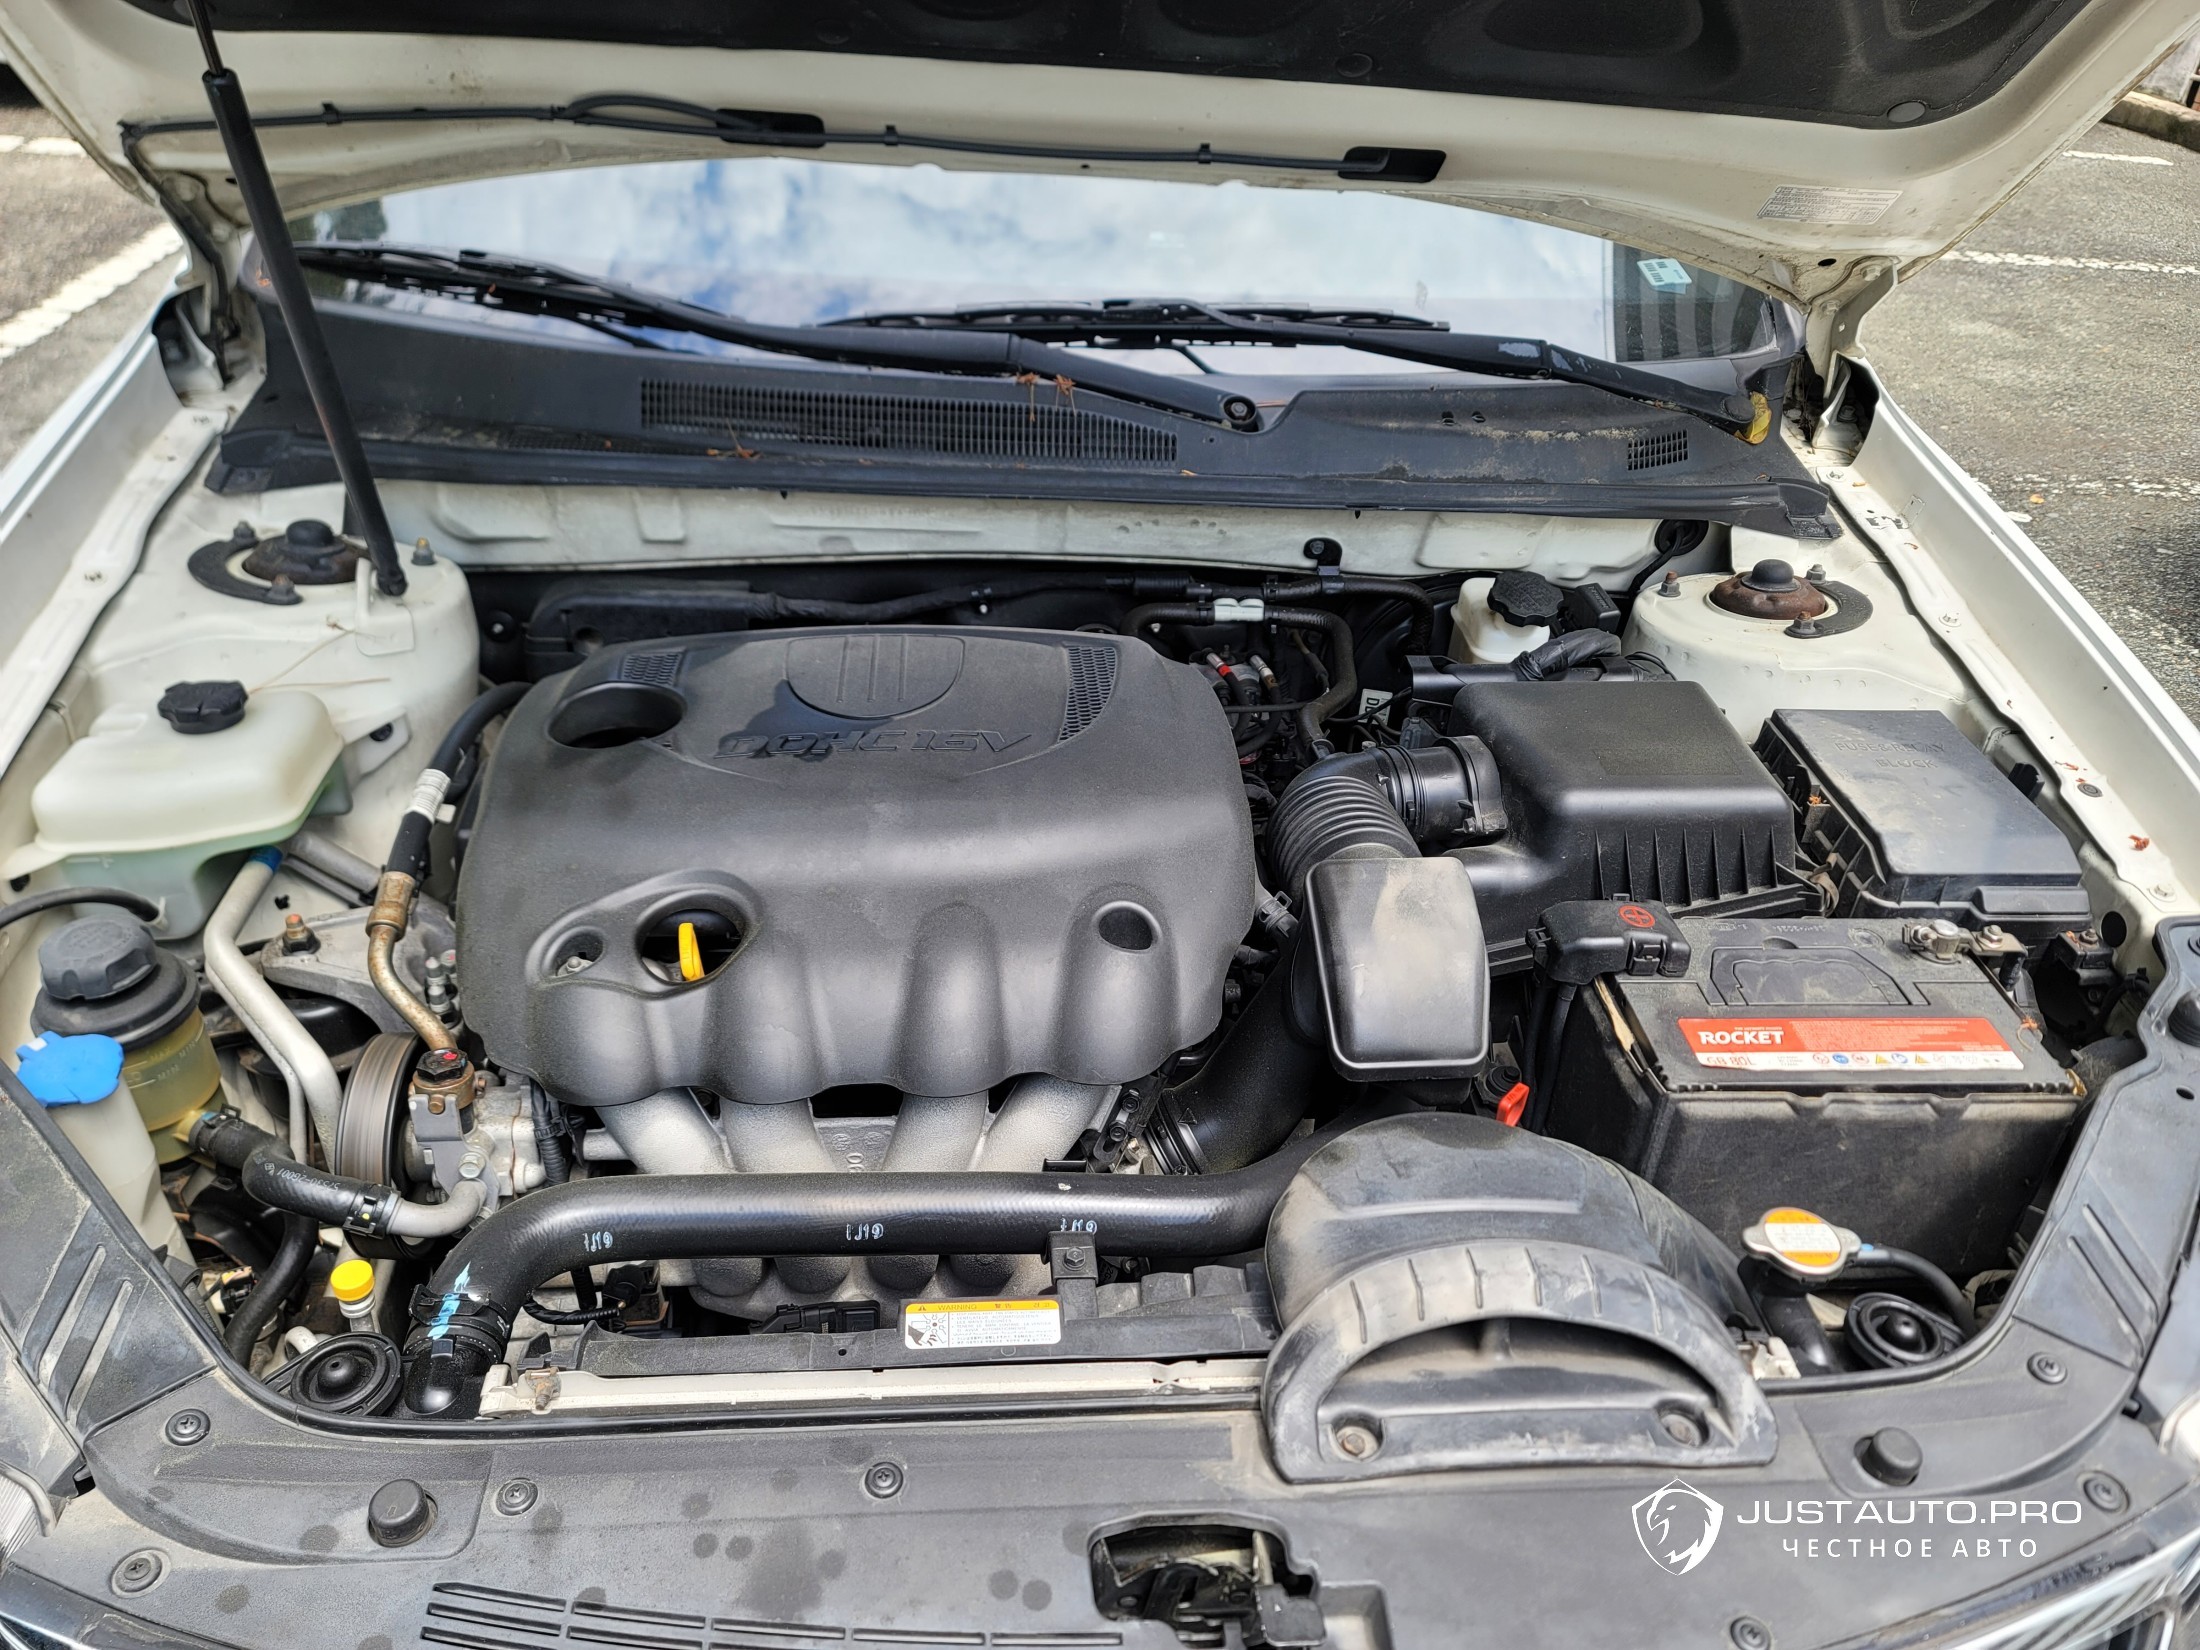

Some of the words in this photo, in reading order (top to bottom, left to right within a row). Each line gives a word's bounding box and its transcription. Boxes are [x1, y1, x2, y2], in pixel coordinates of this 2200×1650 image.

[713, 730, 908, 759] DOHC
[910, 729, 1033, 753] 16V
[1874, 759, 1939, 769] BLOCK
[1697, 1031, 1784, 1045] ROCKET
